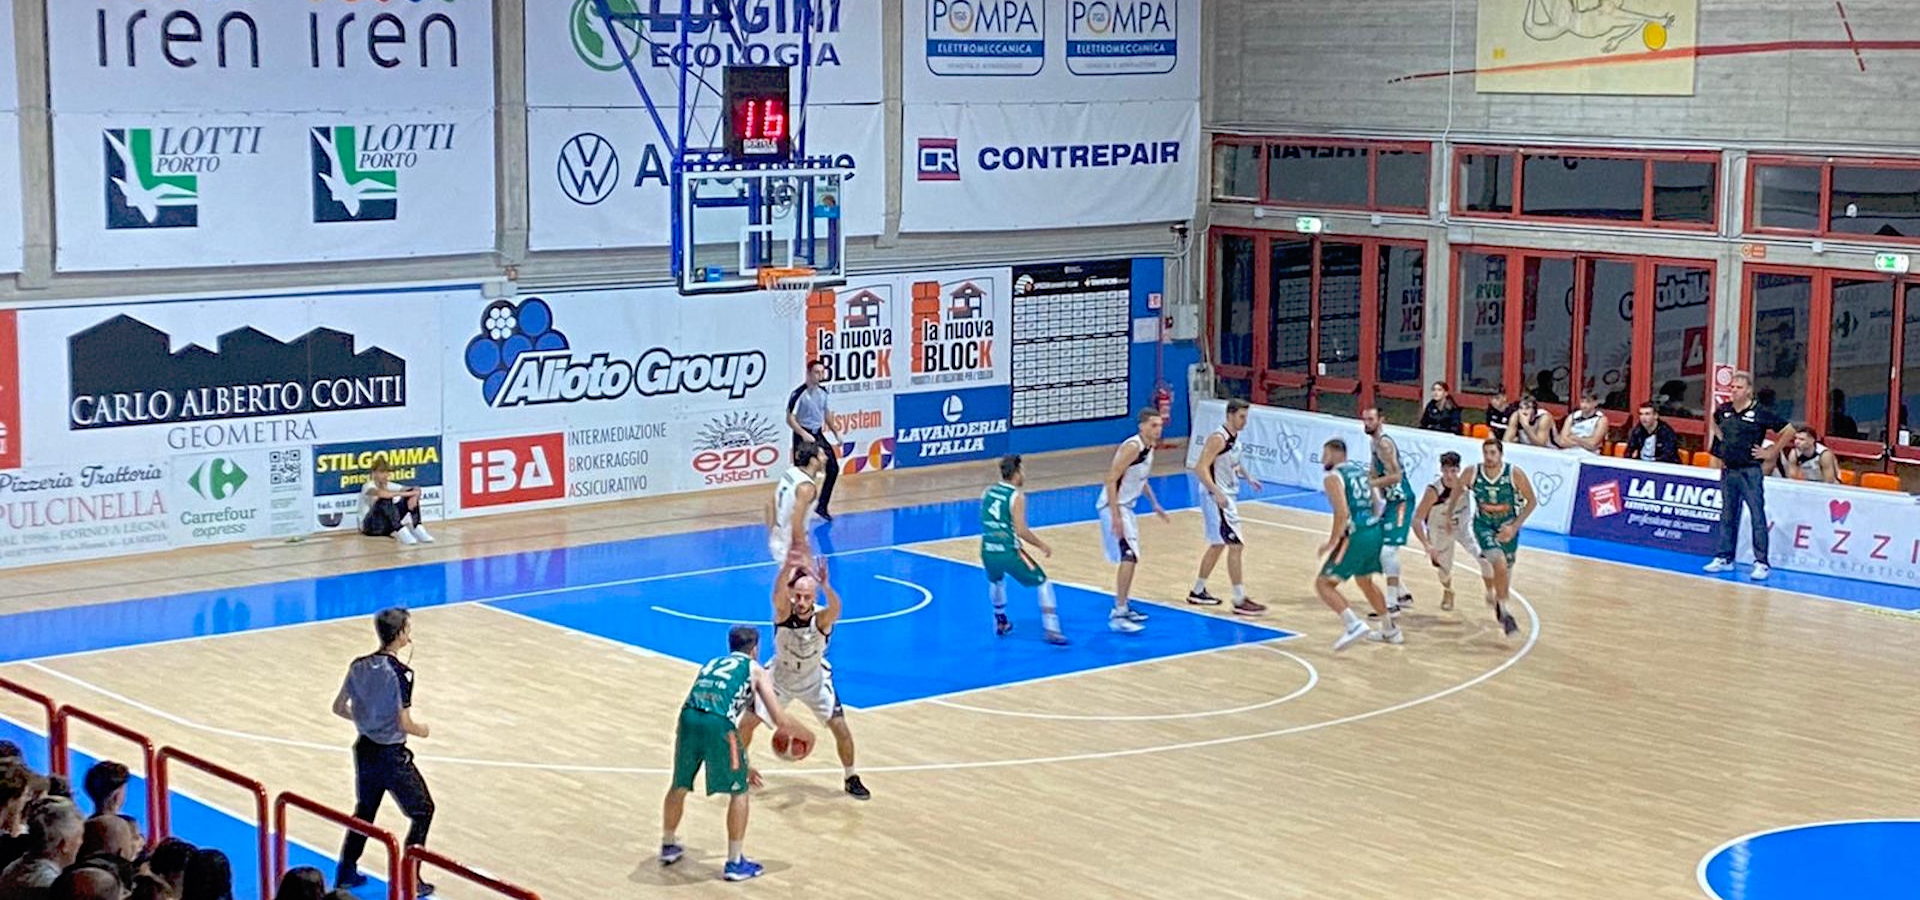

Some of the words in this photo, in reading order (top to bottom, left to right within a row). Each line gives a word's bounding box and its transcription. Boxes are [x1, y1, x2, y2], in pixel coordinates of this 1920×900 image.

[932, 0, 1038, 34] POMPA
[1072, 0, 1171, 34] POMPA
[651, 43, 841, 67] ECOLOGIA
[937, 42, 1033, 54] ELETTROMECCANICA
[745, 99, 784, 138] 16
[158, 126, 265, 155] LOTTI
[361, 123, 459, 151] LOTTI
[156, 153, 220, 173] PORTO
[358, 151, 418, 169] PORTO
[919, 150, 958, 173] CR
[978, 141, 1180, 171] CONTREPAIR
[819, 328, 834, 350] la
[840, 328, 892, 349] nuova
[923, 320, 938, 341] la
[944, 320, 994, 340] nuova
[818, 349, 892, 383] BLOCK
[923, 340, 993, 373] BLOCK
[499, 351, 632, 407] Alioto
[635, 347, 766, 400] Group
[71, 390, 171, 427] CARLO
[180, 380, 302, 419] ALBERTO
[310, 374, 403, 410] CONTI
[167, 417, 318, 450] GEOMETRA
[567, 422, 668, 447] INTERMEDIAZIONE
[896, 418, 1008, 444] LAVANDERIA
[918, 437, 985, 458] ITALIA
[568, 450, 649, 474] BROKERAGGIO
[0, 472, 74, 493] Pizzeria
[81, 464, 163, 489] Trattoria
[340, 468, 416, 489] pneuatici
[568, 475, 648, 499] ASSICURATIVO
[704, 468, 770, 486] system
[1627, 477, 1656, 500] LA
[180, 507, 258, 526] Carrefour
[192, 522, 247, 539] express
